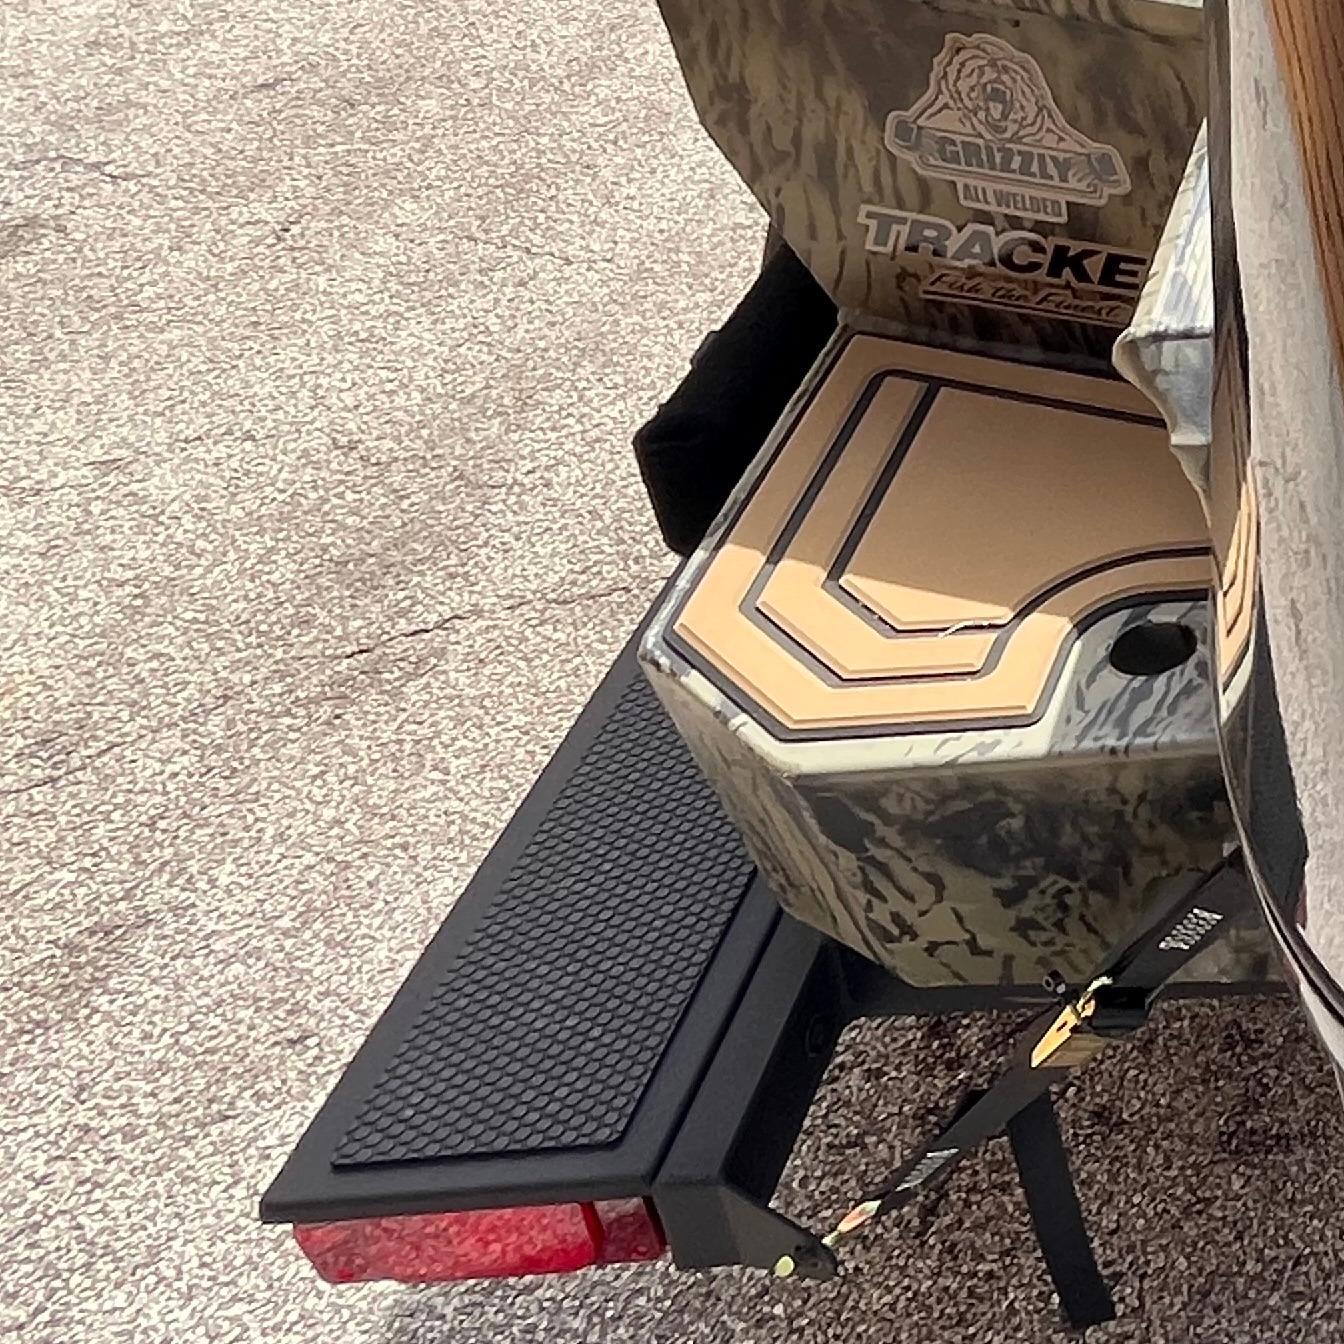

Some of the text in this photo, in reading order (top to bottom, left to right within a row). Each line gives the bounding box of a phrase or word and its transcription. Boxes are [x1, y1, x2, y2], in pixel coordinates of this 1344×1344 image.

[936, 136, 1073, 184] GRIZZLY
[962, 183, 1063, 218] ALL WELDED
[862, 209, 1149, 290] TRACKE
